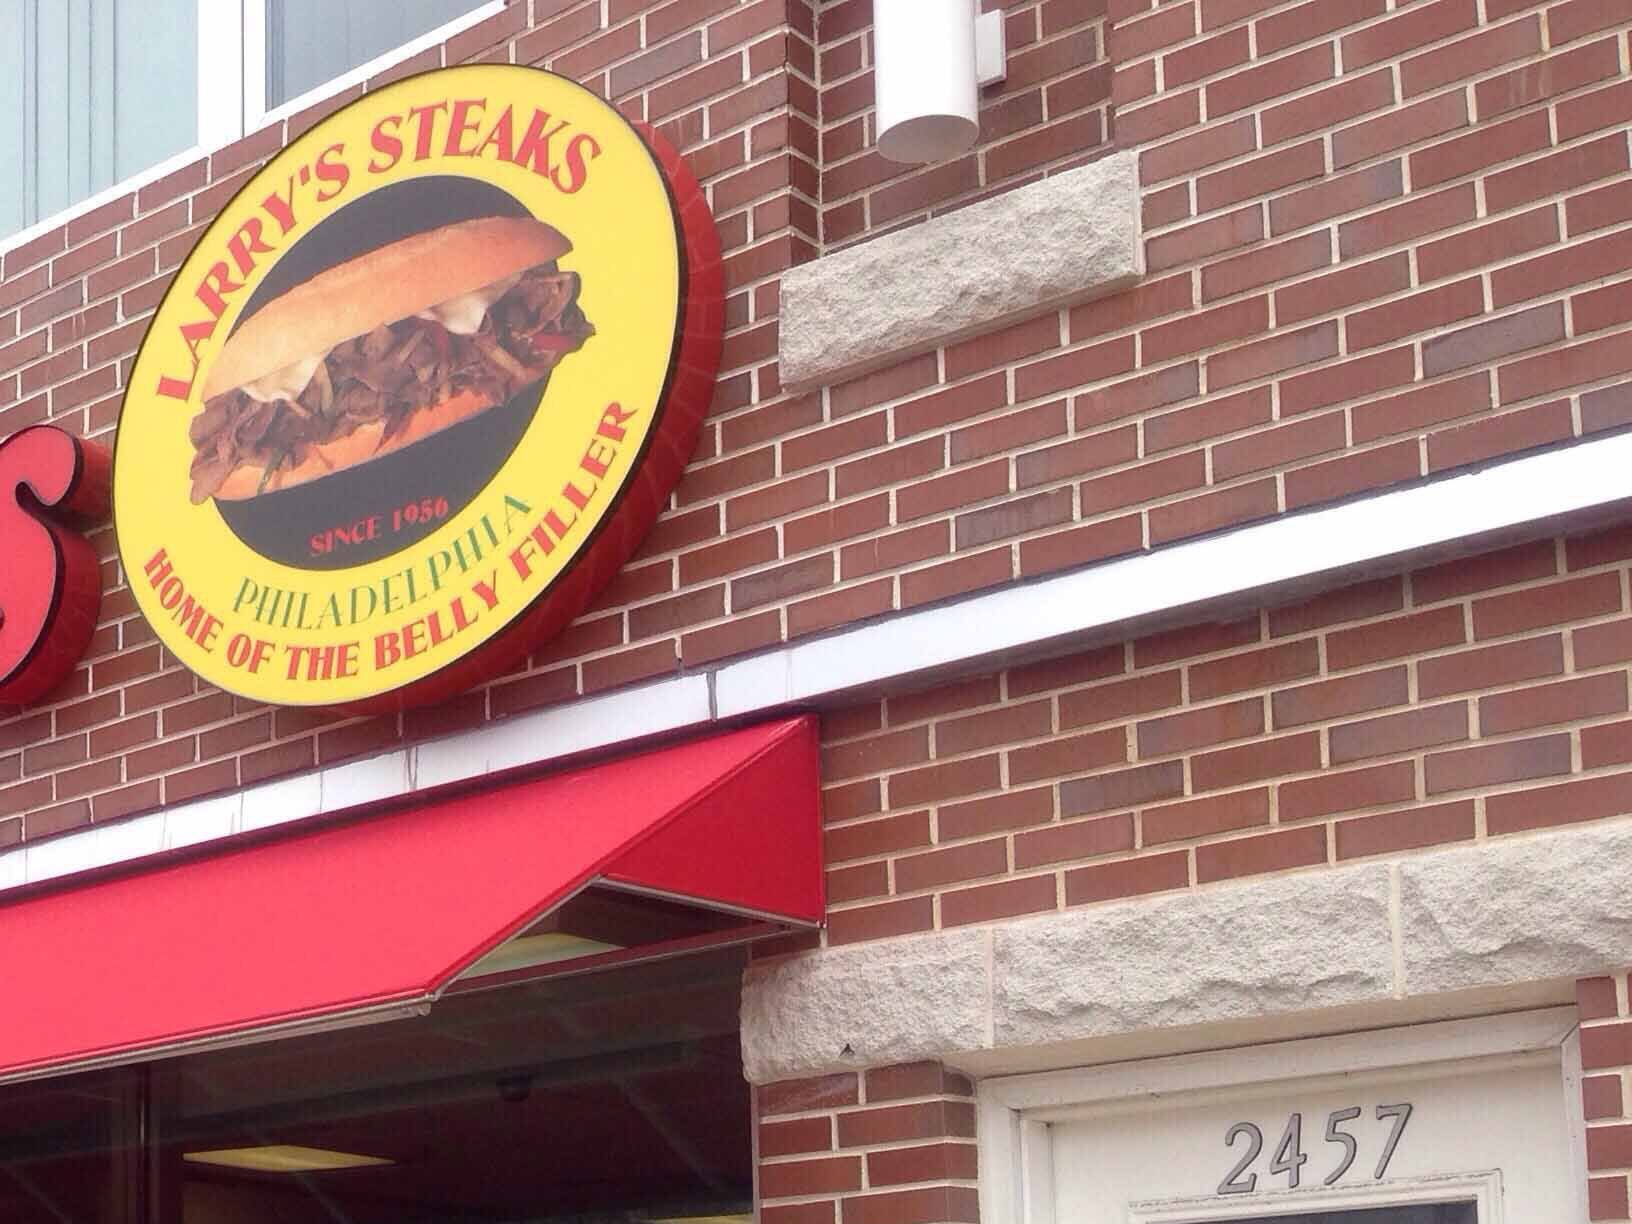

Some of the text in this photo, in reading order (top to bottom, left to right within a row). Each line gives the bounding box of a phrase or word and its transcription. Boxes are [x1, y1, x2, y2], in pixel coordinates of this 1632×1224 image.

[156, 96, 602, 403] LARRY'S STEAKS
[142, 401, 639, 683] HOME OF THE BELLY FILLER
[232, 493, 534, 631] PHILADELPHIA
[309, 496, 449, 557] SINCE 1950
[1217, 1103, 1413, 1195] 2457
